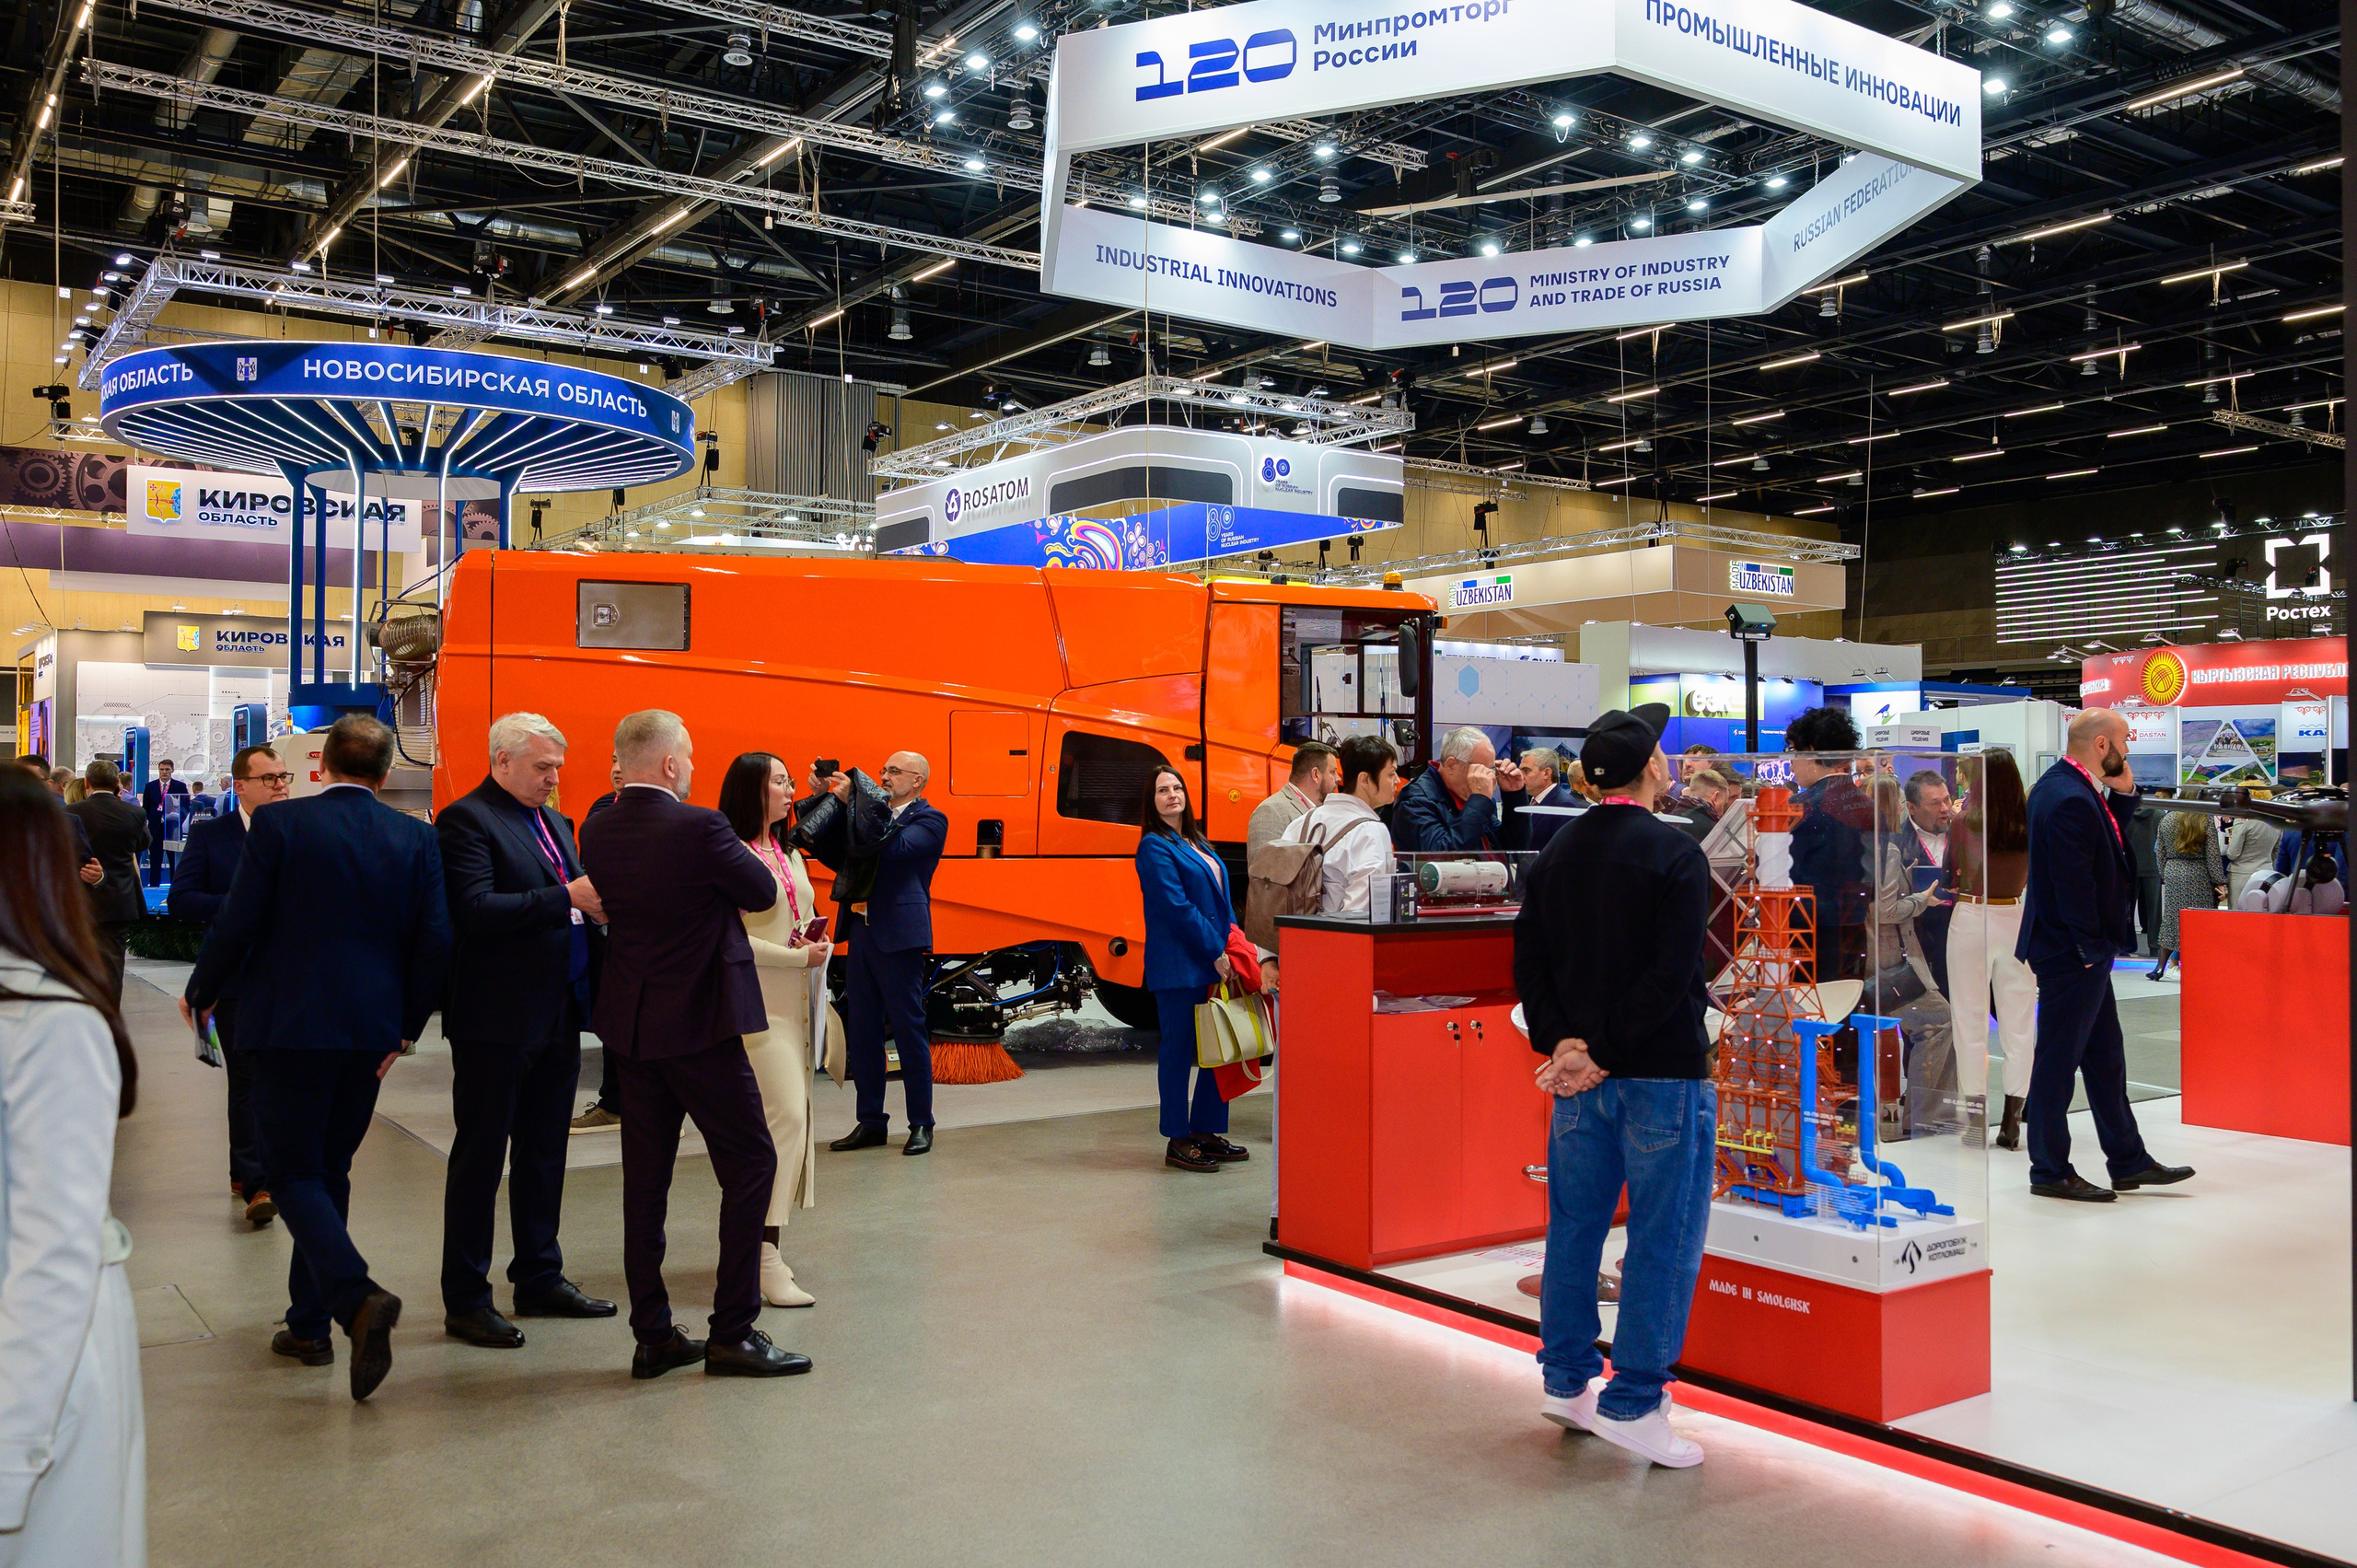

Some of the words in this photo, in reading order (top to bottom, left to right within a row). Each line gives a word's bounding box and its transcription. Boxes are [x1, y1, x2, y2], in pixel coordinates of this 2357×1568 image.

[1314, 0, 1514, 45] Минпромторг
[1136, 29, 1297, 102] 120
[1314, 40, 1417, 72] России
[1646, 0, 1840, 85] ПРОМЫШЛЕННЫЕ
[1845, 64, 1961, 128] ИННОВАЦИИ
[1794, 203, 1840, 252] RUSSIAN
[1096, 244, 1213, 284] INDUSTRIAL
[1217, 268, 1338, 308] INNOVATIONS
[1530, 267, 1610, 288] MINISTRY
[1614, 265, 1637, 280] OF
[1642, 255, 1730, 276] INDUSTRY
[1401, 276, 1518, 321] 120
[1529, 290, 1565, 308] AND
[1571, 286, 1626, 304] TRADE
[1631, 283, 1653, 296] OF
[1658, 276, 1722, 295] RUSSIA
[120, 363, 193, 392] ОБЛАСТЬ
[304, 358, 551, 399] НОВОСИБИРСКАЯ
[557, 381, 647, 418] ОБЛАСТЬ
[964, 477, 1028, 511] ROSATOM
[198, 511, 278, 527] ОБЛАСТЬ
[1731, 560, 1739, 589] MADE
[1739, 571, 1794, 594] UZBEKISTAN
[1448, 581, 1457, 608] MADE
[1456, 584, 1512, 607] UZBEKISTAN
[2267, 605, 2331, 621] Ростех
[215, 630, 345, 647] КИРОВКАЯ
[215, 645, 265, 653] ОБЛАСТЬ
[2191, 666, 2280, 683] КЫРГЫЗСКАЯ
[2282, 663, 2349, 679] РЕСПУБЛ
[1926, 1237, 1968, 1252] ДОРОГОБУЖ
[1929, 1248, 1966, 1261] КОТЛОМАШ
[1709, 1279, 1737, 1296] MADE
